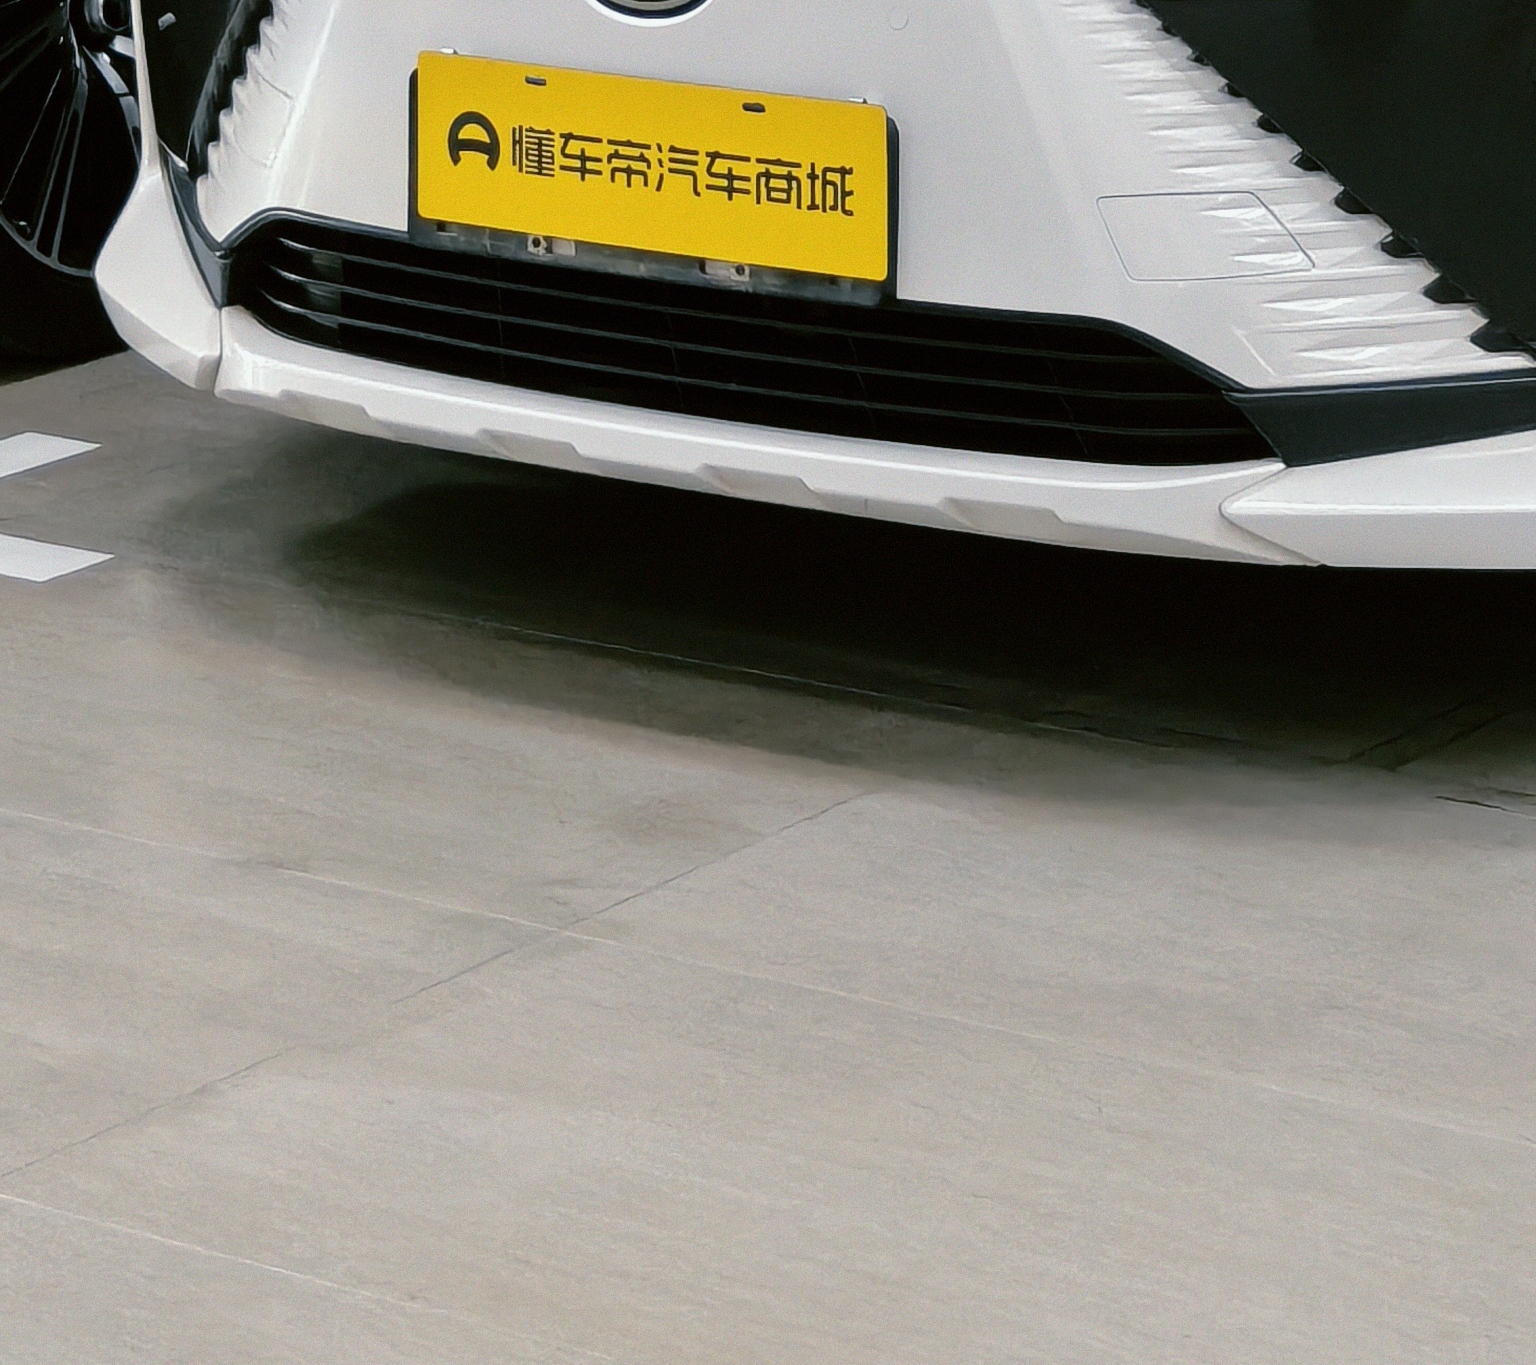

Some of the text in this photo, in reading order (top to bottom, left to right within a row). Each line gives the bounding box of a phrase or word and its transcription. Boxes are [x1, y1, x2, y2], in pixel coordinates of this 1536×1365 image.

[511, 123, 854, 217] 懂车帝汽车商城
